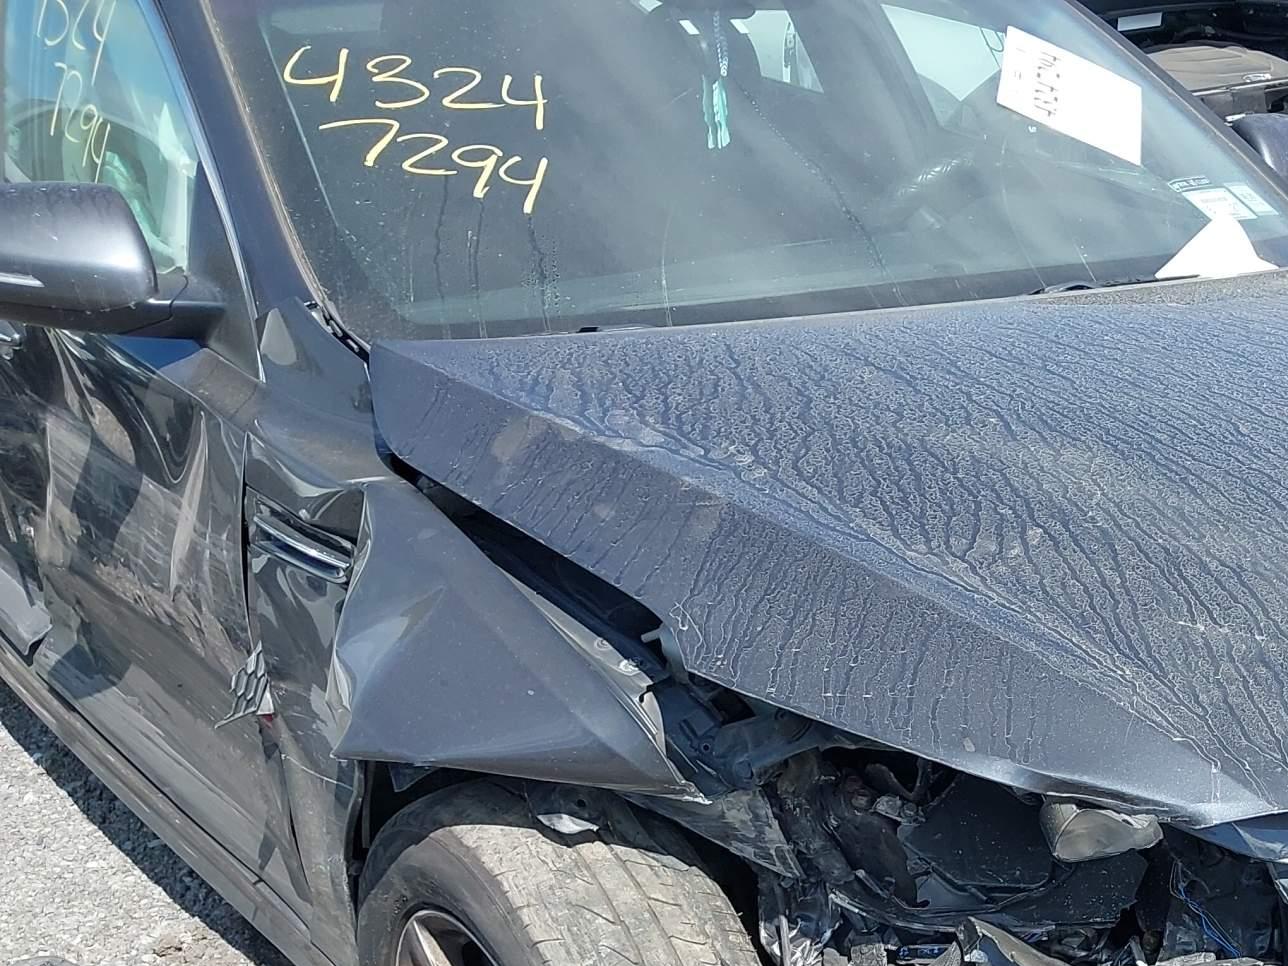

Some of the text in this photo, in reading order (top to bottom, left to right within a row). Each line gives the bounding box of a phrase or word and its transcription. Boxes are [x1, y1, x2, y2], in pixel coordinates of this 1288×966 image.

[51, 62, 111, 183] 7294
[283, 45, 549, 130] 4324
[318, 118, 549, 214] 7294
